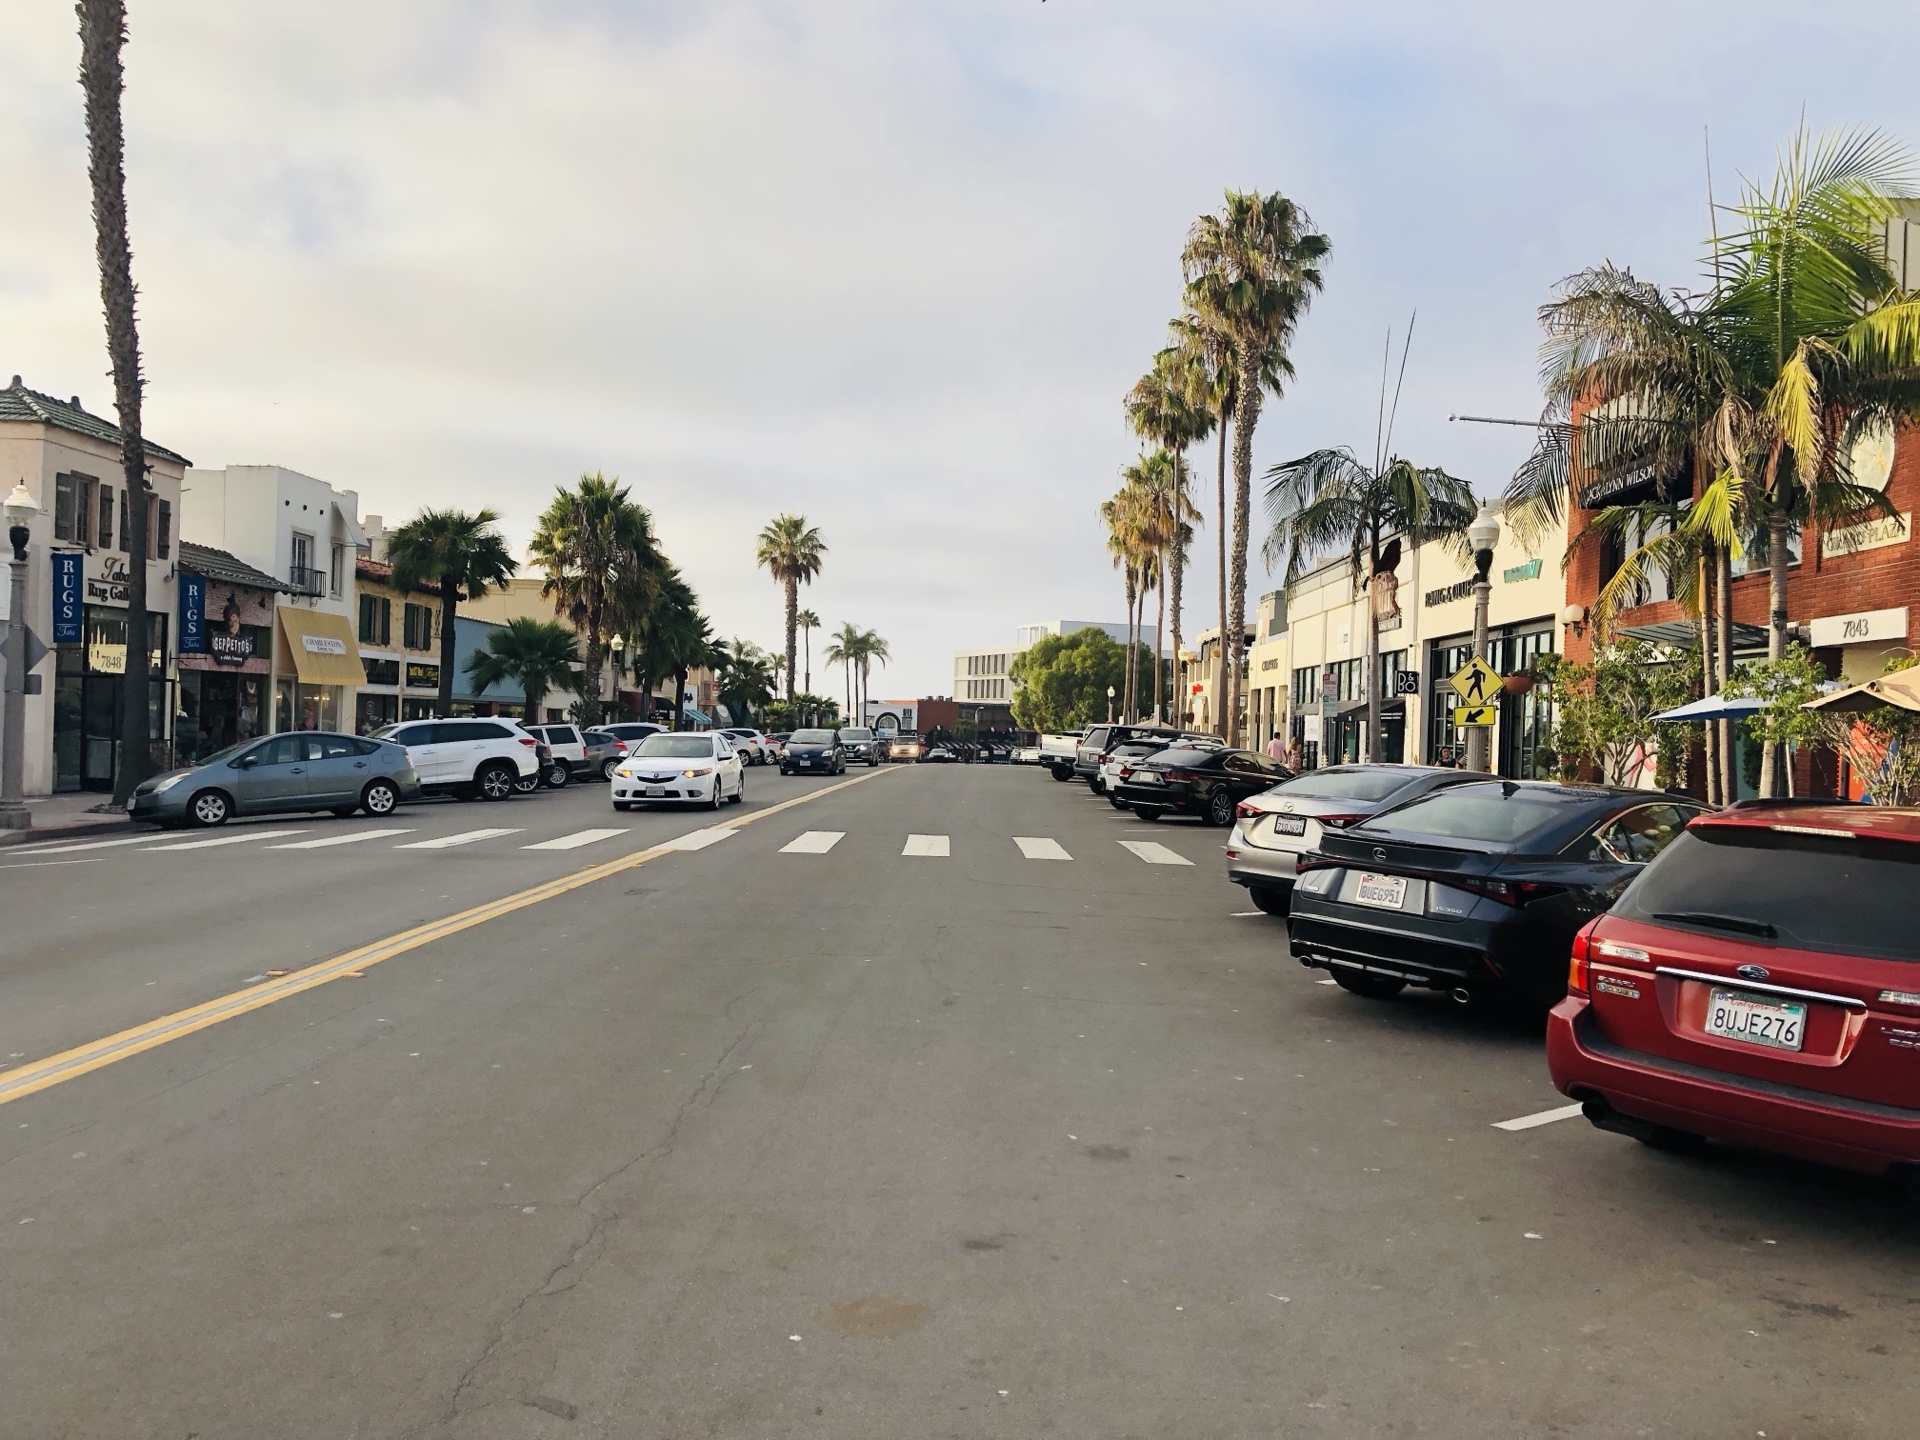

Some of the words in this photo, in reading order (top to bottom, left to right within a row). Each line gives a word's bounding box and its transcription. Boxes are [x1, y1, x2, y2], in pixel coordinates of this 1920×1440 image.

[1626, 463, 1656, 487] WILSON
[63, 560, 74, 618] RUGS
[87, 582, 108, 602] Rug
[109, 586, 130, 601] Gall
[1843, 619, 1869, 638] 7843
[101, 655, 122, 669] 7848
[1714, 1008, 1798, 1042] 8UJE276
